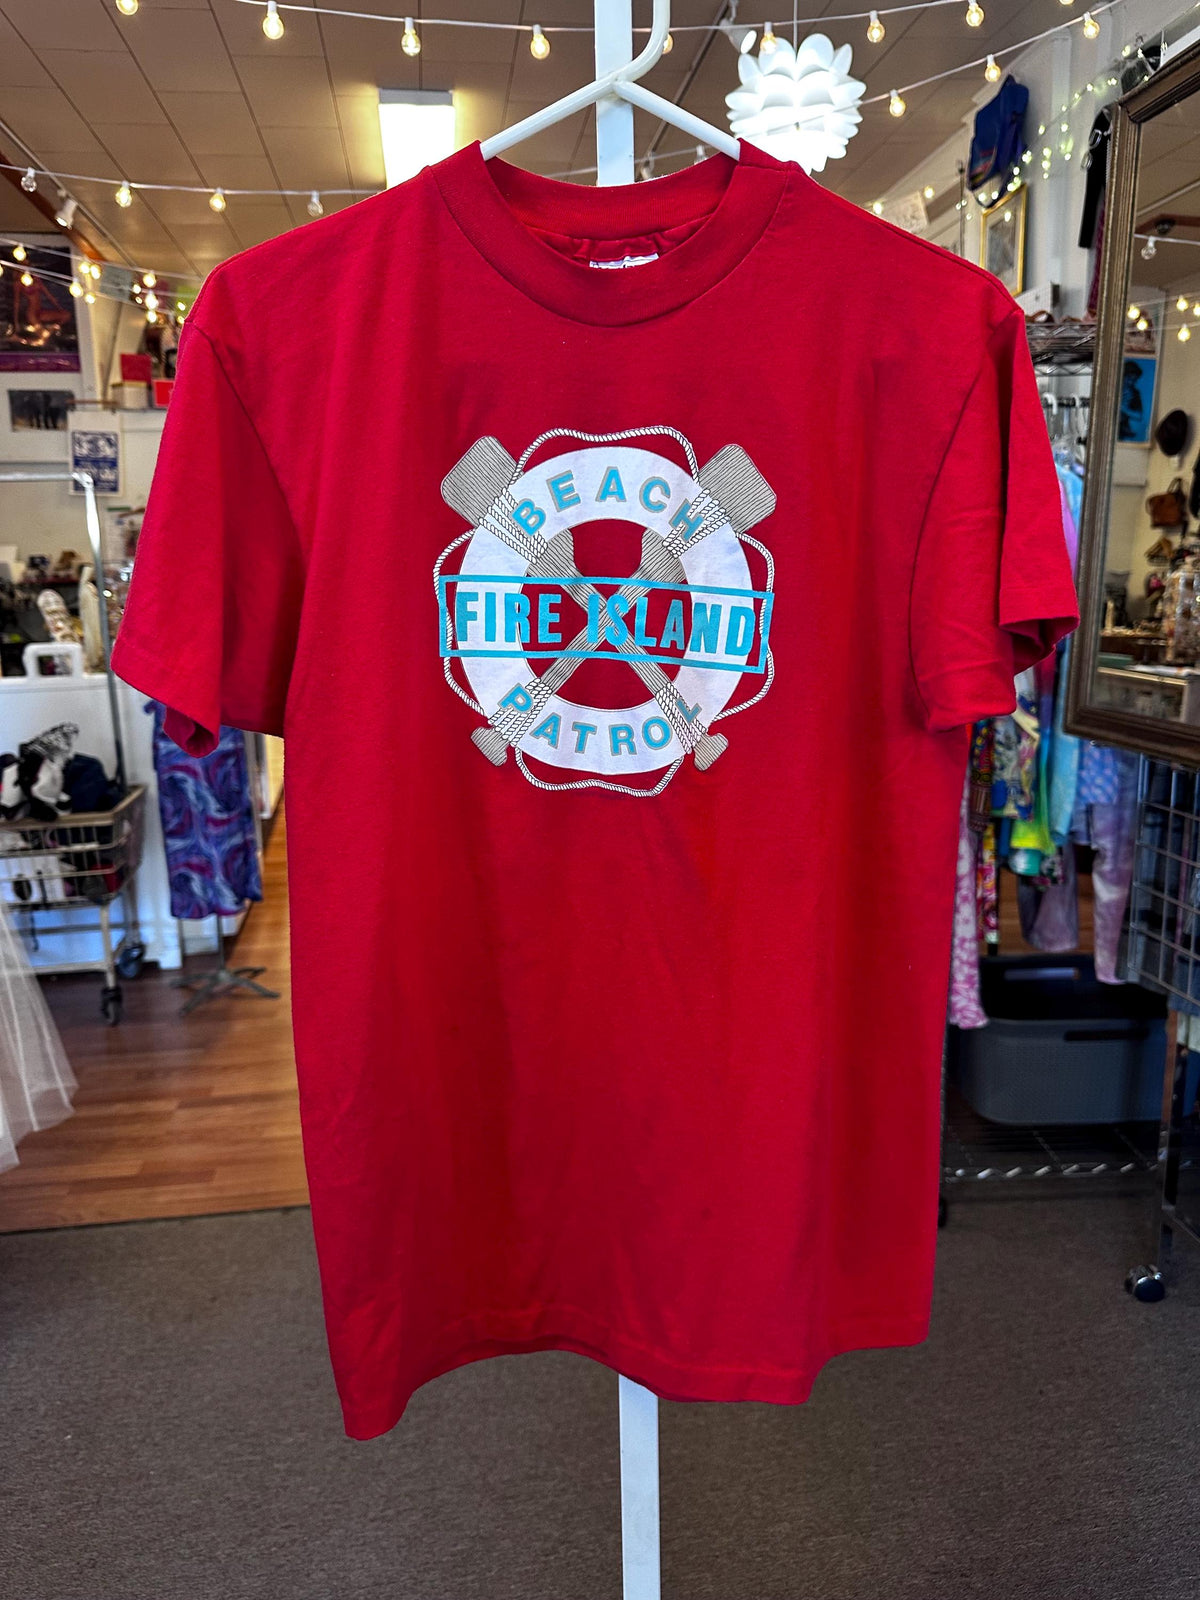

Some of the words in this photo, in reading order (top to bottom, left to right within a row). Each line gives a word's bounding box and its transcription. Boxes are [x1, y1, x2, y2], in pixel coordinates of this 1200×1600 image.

[511, 466, 705, 541] BEACH
[455, 592, 562, 644] FIRE
[586, 594, 756, 656] ISLAND
[497, 683, 702, 756] PATROL
